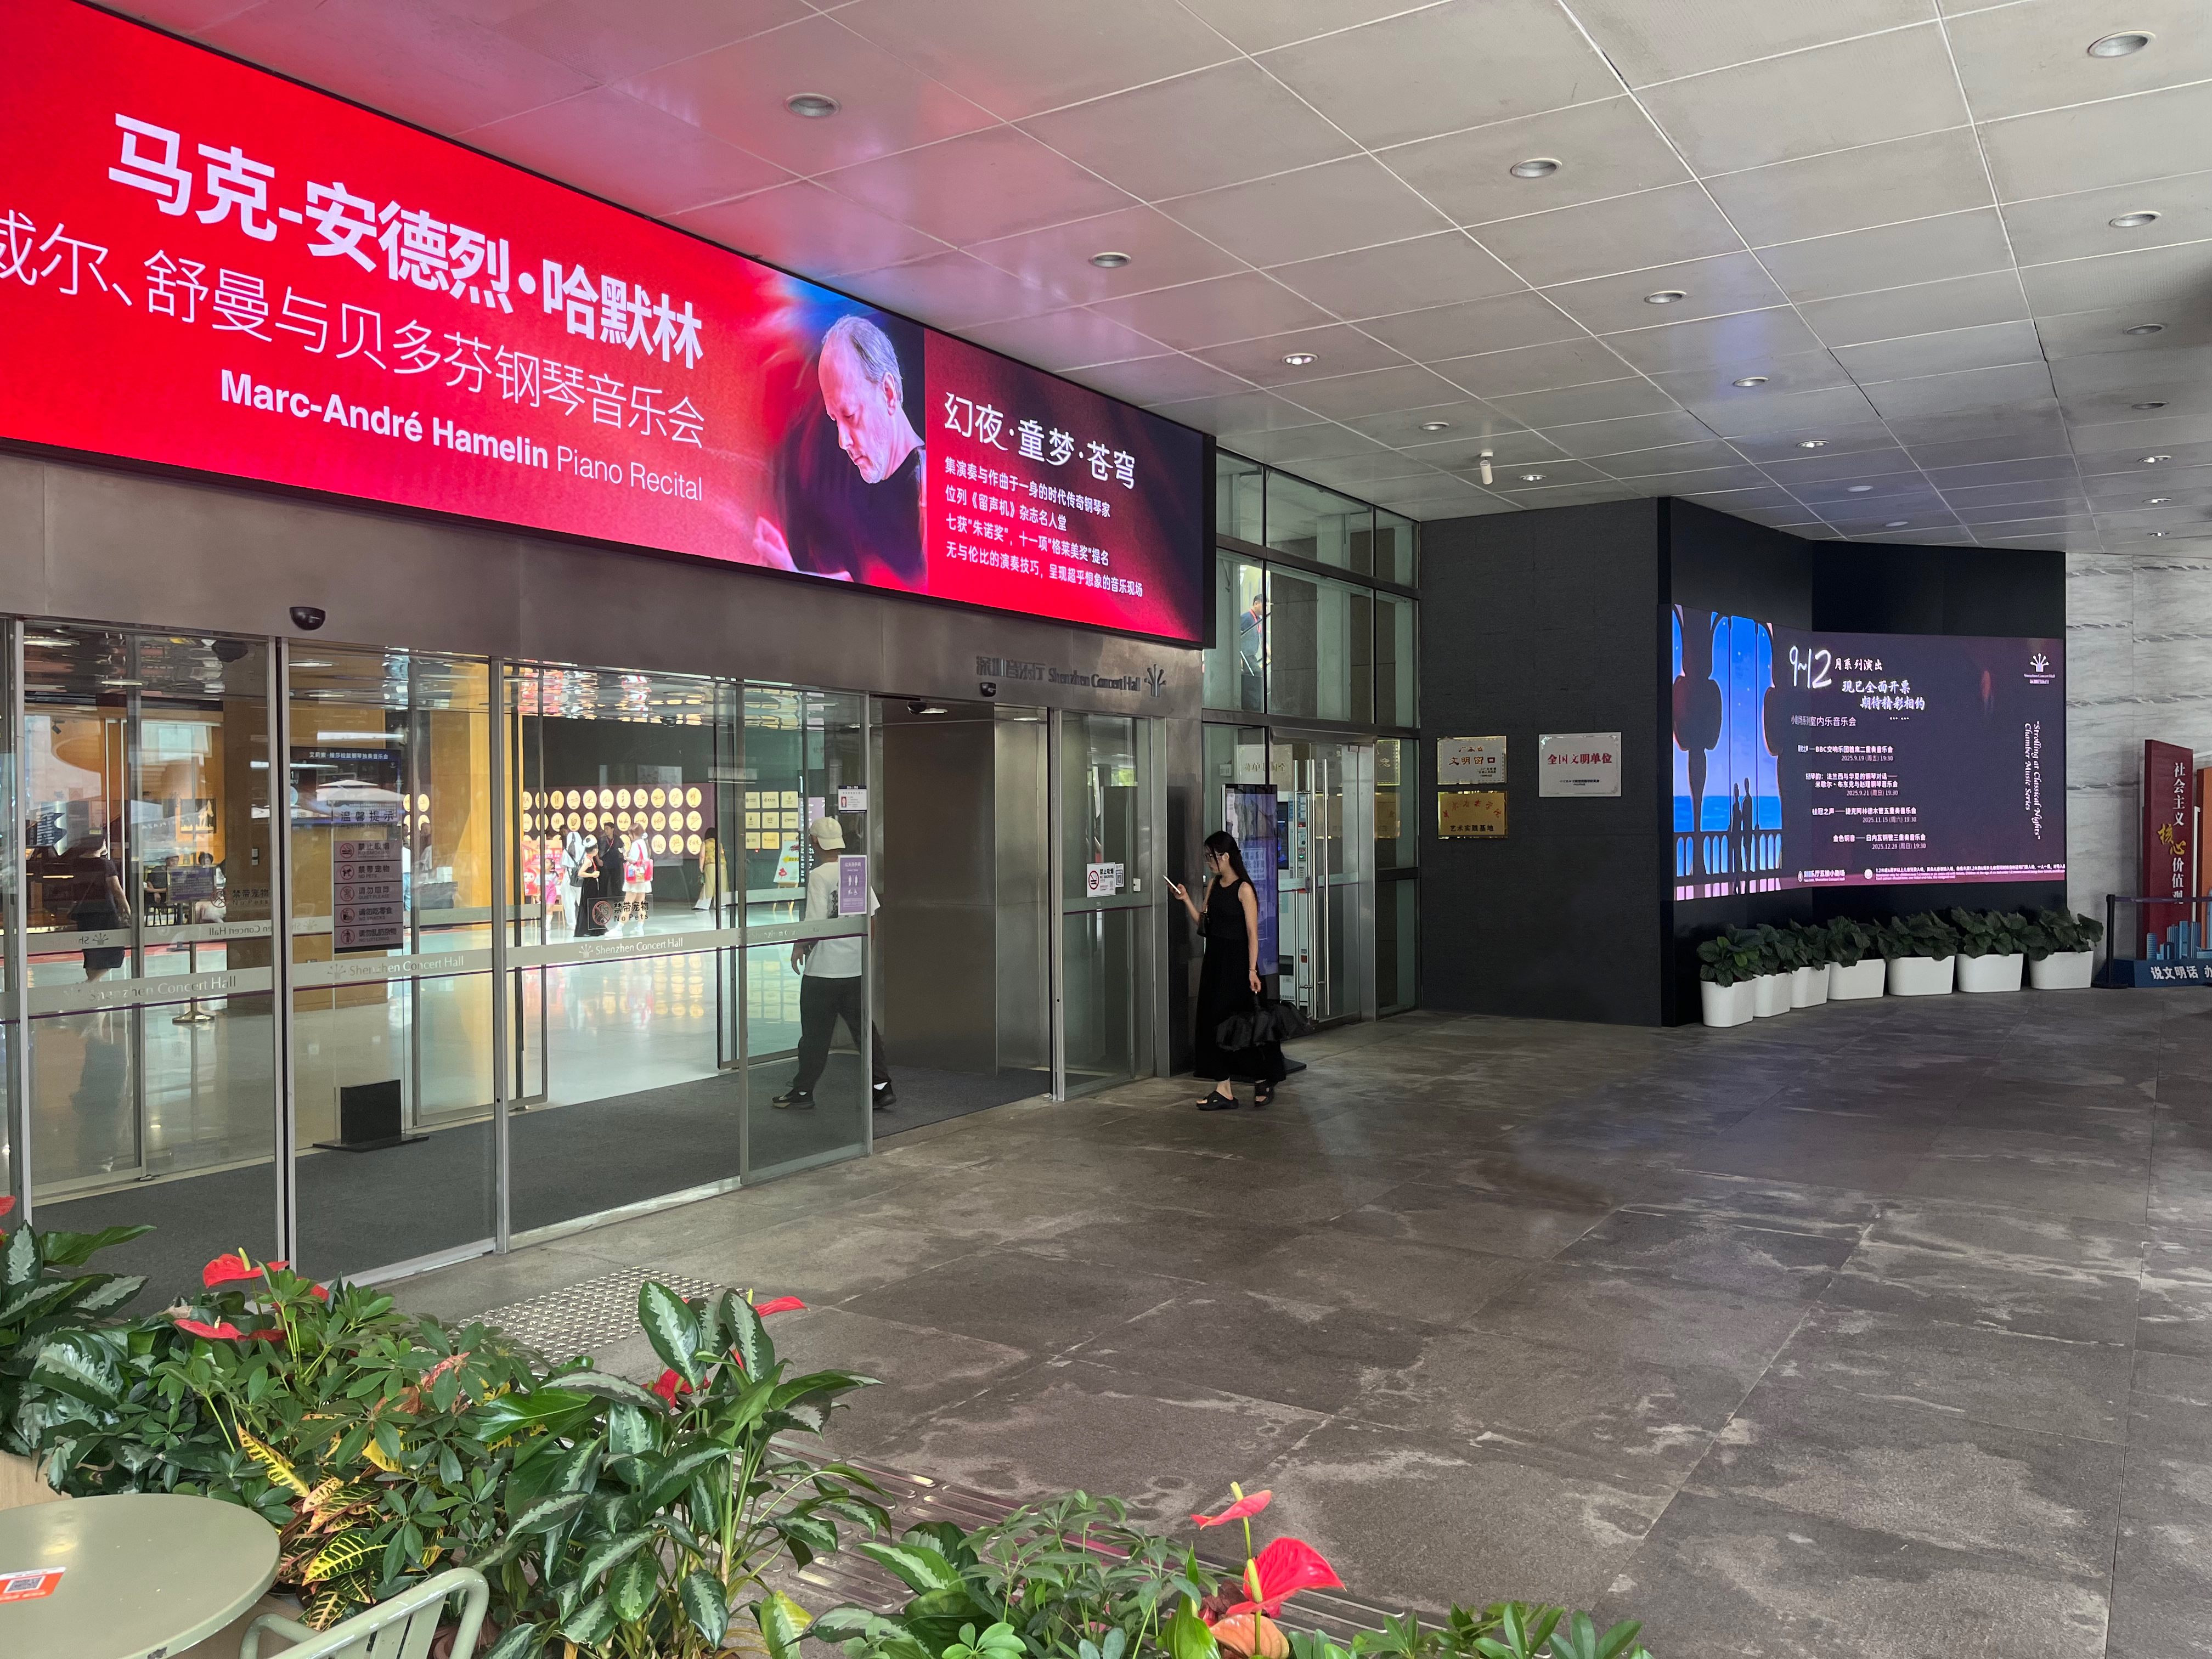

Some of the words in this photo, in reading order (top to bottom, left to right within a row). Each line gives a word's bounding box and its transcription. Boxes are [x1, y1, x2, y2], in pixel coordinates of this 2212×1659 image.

[221, 369, 423, 442] Marc-André
[433, 417, 549, 469] Hamelin
[557, 444, 622, 484] Piano
[631, 461, 702, 501] Recital
[945, 456, 1111, 518] 集演奏与作曲于一身的时代传奇钢琴家
[945, 484, 1067, 532] 位列《留声机》杂志名人堂
[1835, 658, 1883, 672] 月系列演出
[1841, 679, 1911, 695] 现已全面开票
[1859, 695, 1926, 711] 期待精彩相约
[1448, 757, 1496, 766] 文明窗口
[1547, 753, 1612, 765] 全国文明单位
[2172, 761, 2186, 827] 社会主义
[341, 811, 394, 822] 温馨提示
[2158, 823, 2187, 855] 核心
[613, 901, 649, 913] 禁带宠物
[596, 942, 634, 956] Shenzhen
[636, 940, 667, 951] Concert
[668, 938, 684, 949] Hall
[349, 962, 400, 976] Shenzhen
[402, 957, 442, 972] Concert
[444, 956, 464, 968] Hall
[2150, 966, 2199, 980] 说文明话
[157, 980, 208, 996] Concert
[211, 975, 236, 990] Hall
